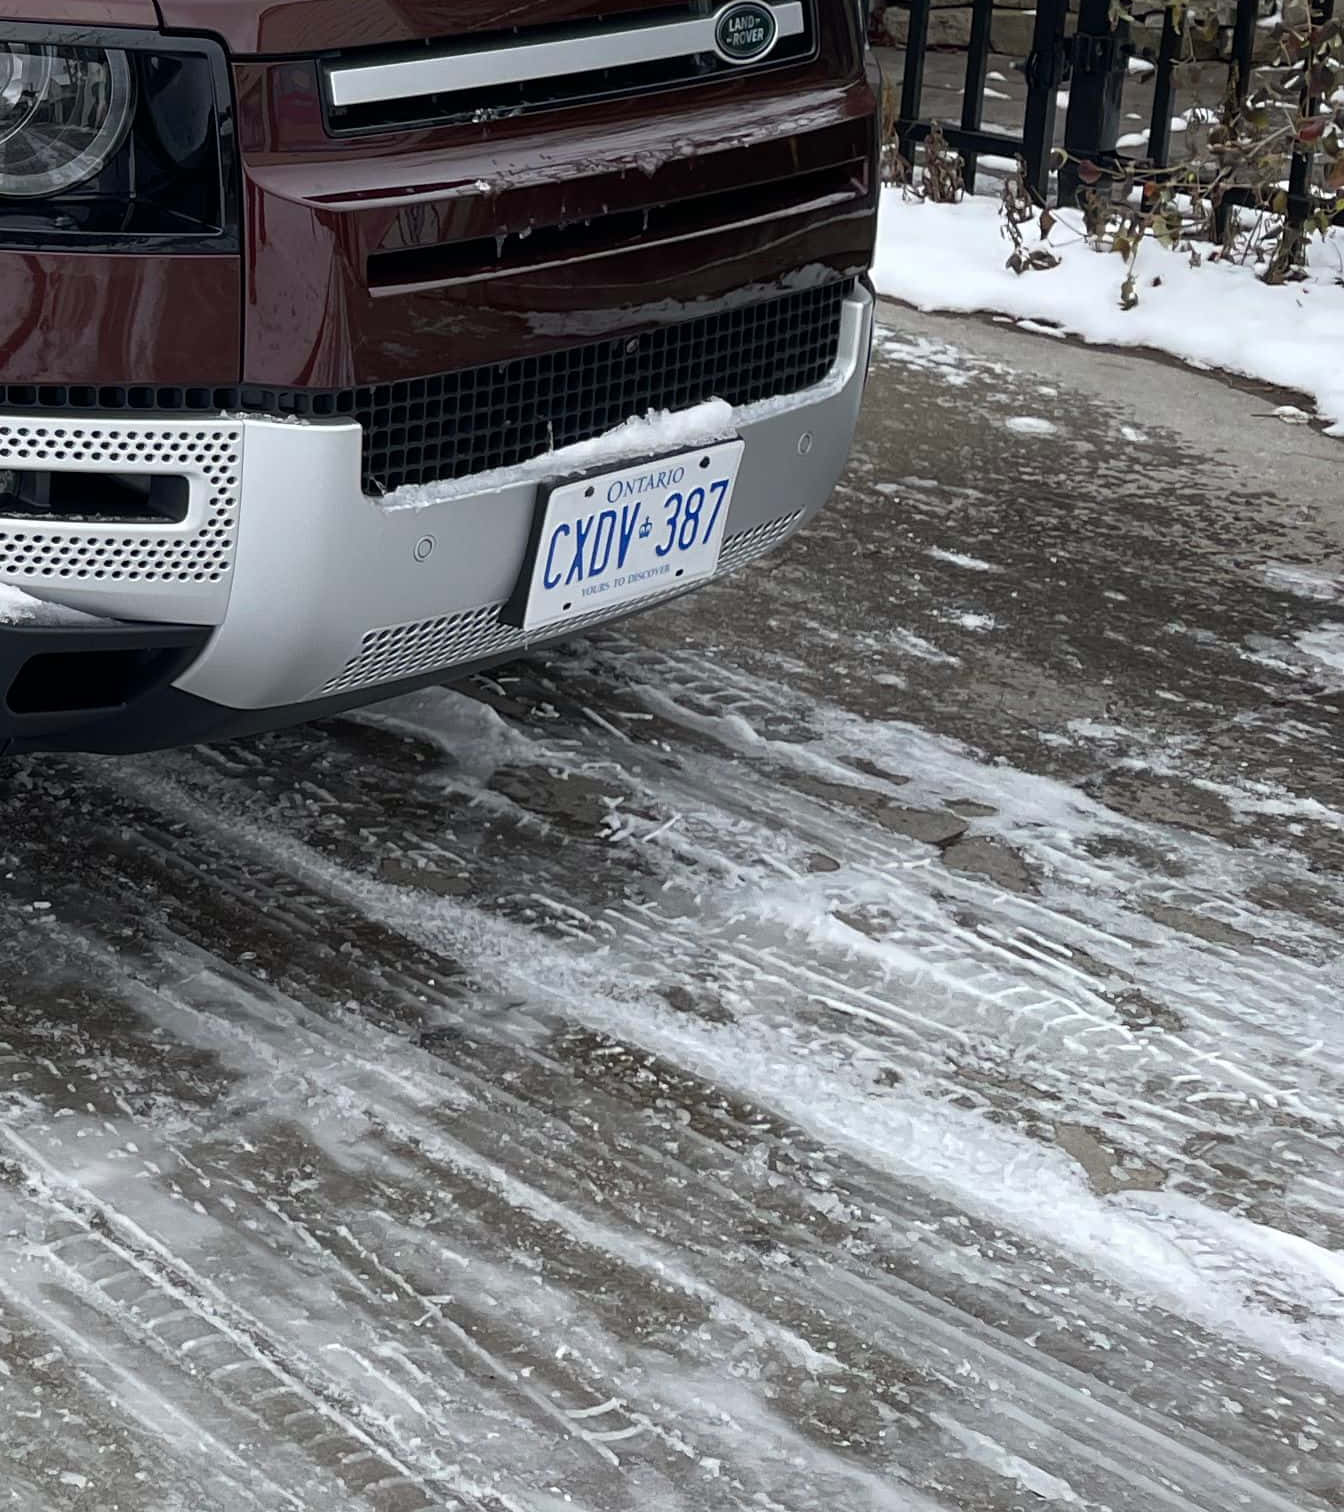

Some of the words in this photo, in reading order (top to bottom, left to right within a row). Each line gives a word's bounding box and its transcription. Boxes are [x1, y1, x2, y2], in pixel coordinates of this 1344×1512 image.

[728, 15, 755, 33] LAND
[732, 27, 765, 46] ROVER
[606, 466, 686, 504] ONTARIO
[542, 501, 642, 591] CXDV
[654, 478, 730, 557] 387
[581, 582, 611, 597] YOURS
[613, 576, 626, 589] TO
[627, 563, 671, 585] DISCOVER
